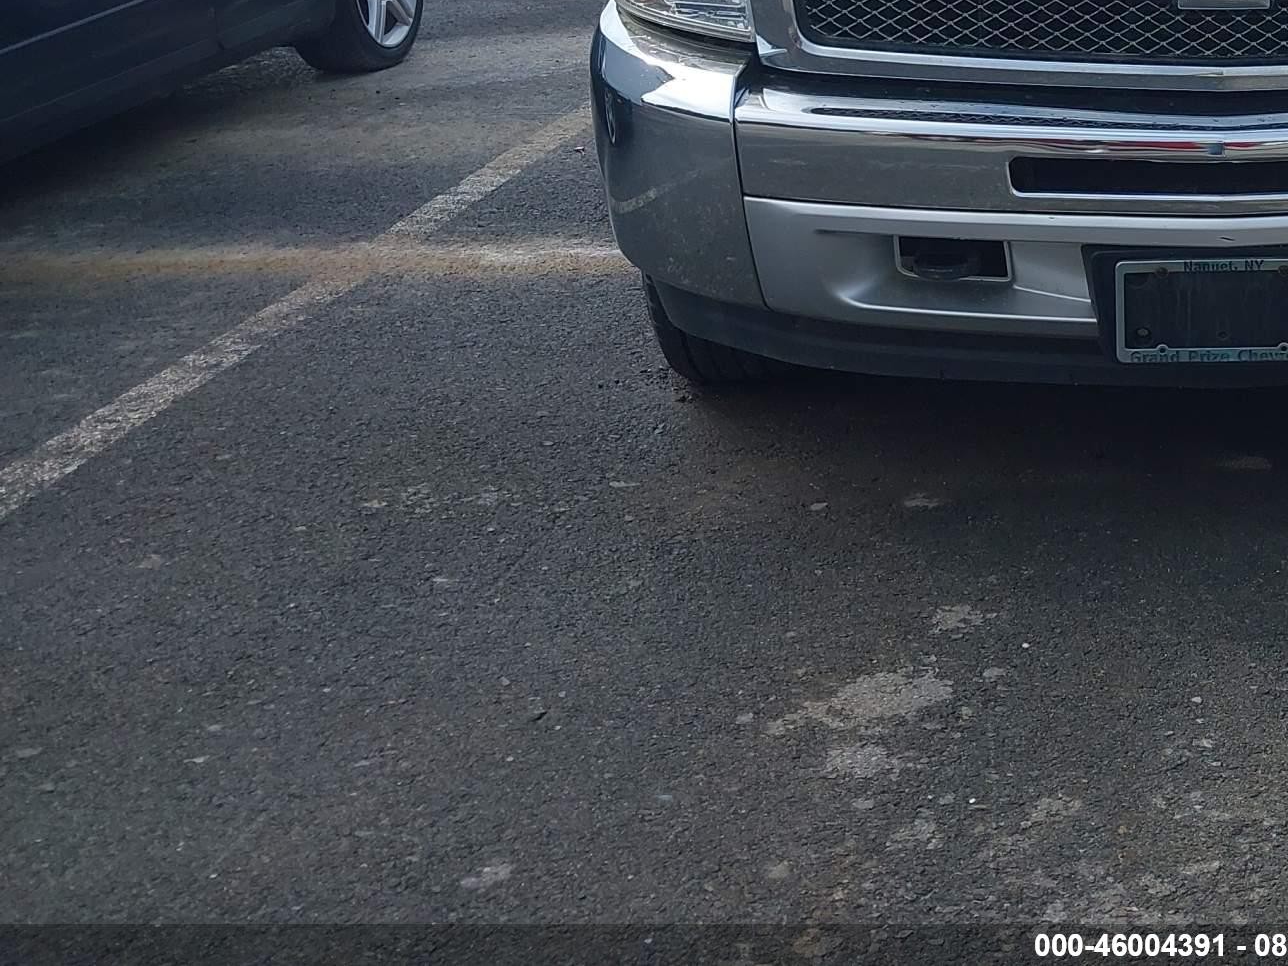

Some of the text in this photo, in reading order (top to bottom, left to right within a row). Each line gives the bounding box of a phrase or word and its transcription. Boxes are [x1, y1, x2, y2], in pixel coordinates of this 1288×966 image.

[1183, 259, 1265, 273] Nanuet, NY
[1130, 350, 1179, 363] Grand
[1188, 350, 1231, 363] Prize
